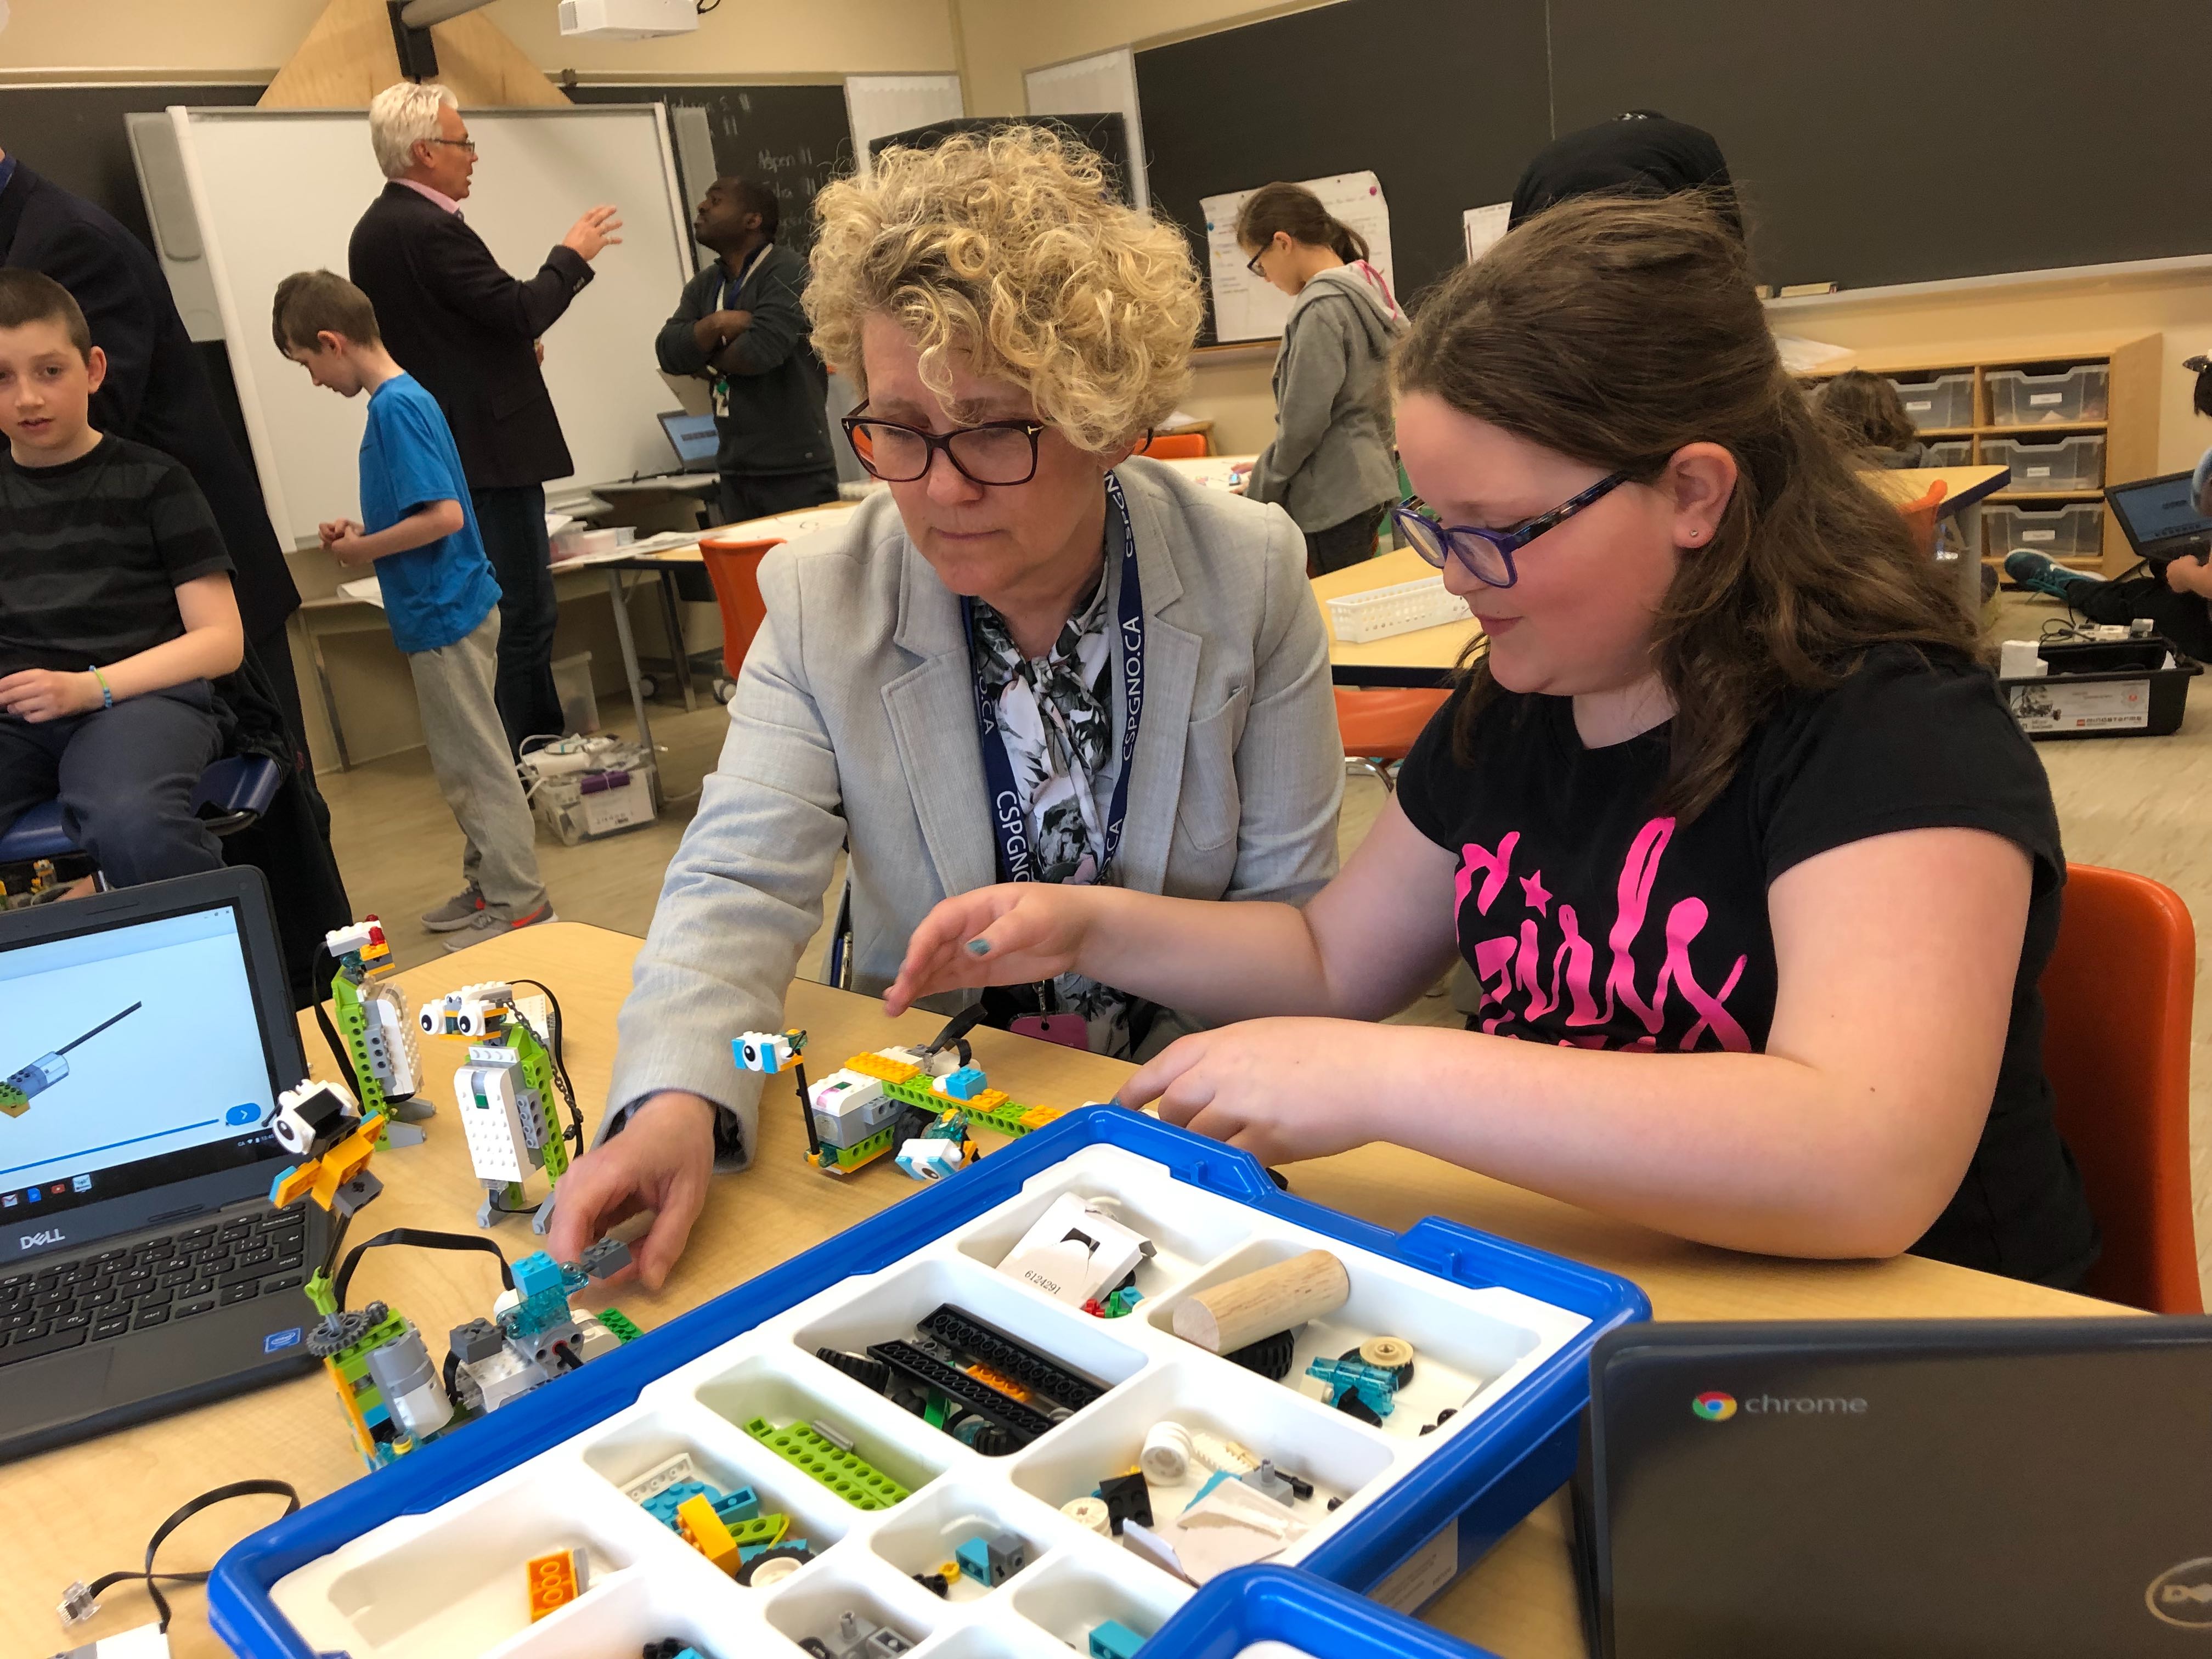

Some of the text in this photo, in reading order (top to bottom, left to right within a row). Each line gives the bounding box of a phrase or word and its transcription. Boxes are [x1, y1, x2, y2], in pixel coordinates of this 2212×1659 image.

[1123, 616, 1141, 762] CSPGNO.CA
[20, 1228, 66, 1250] DELL
[1024, 1270, 1061, 1294] 6124291
[1745, 1393, 1867, 1413] chrome
